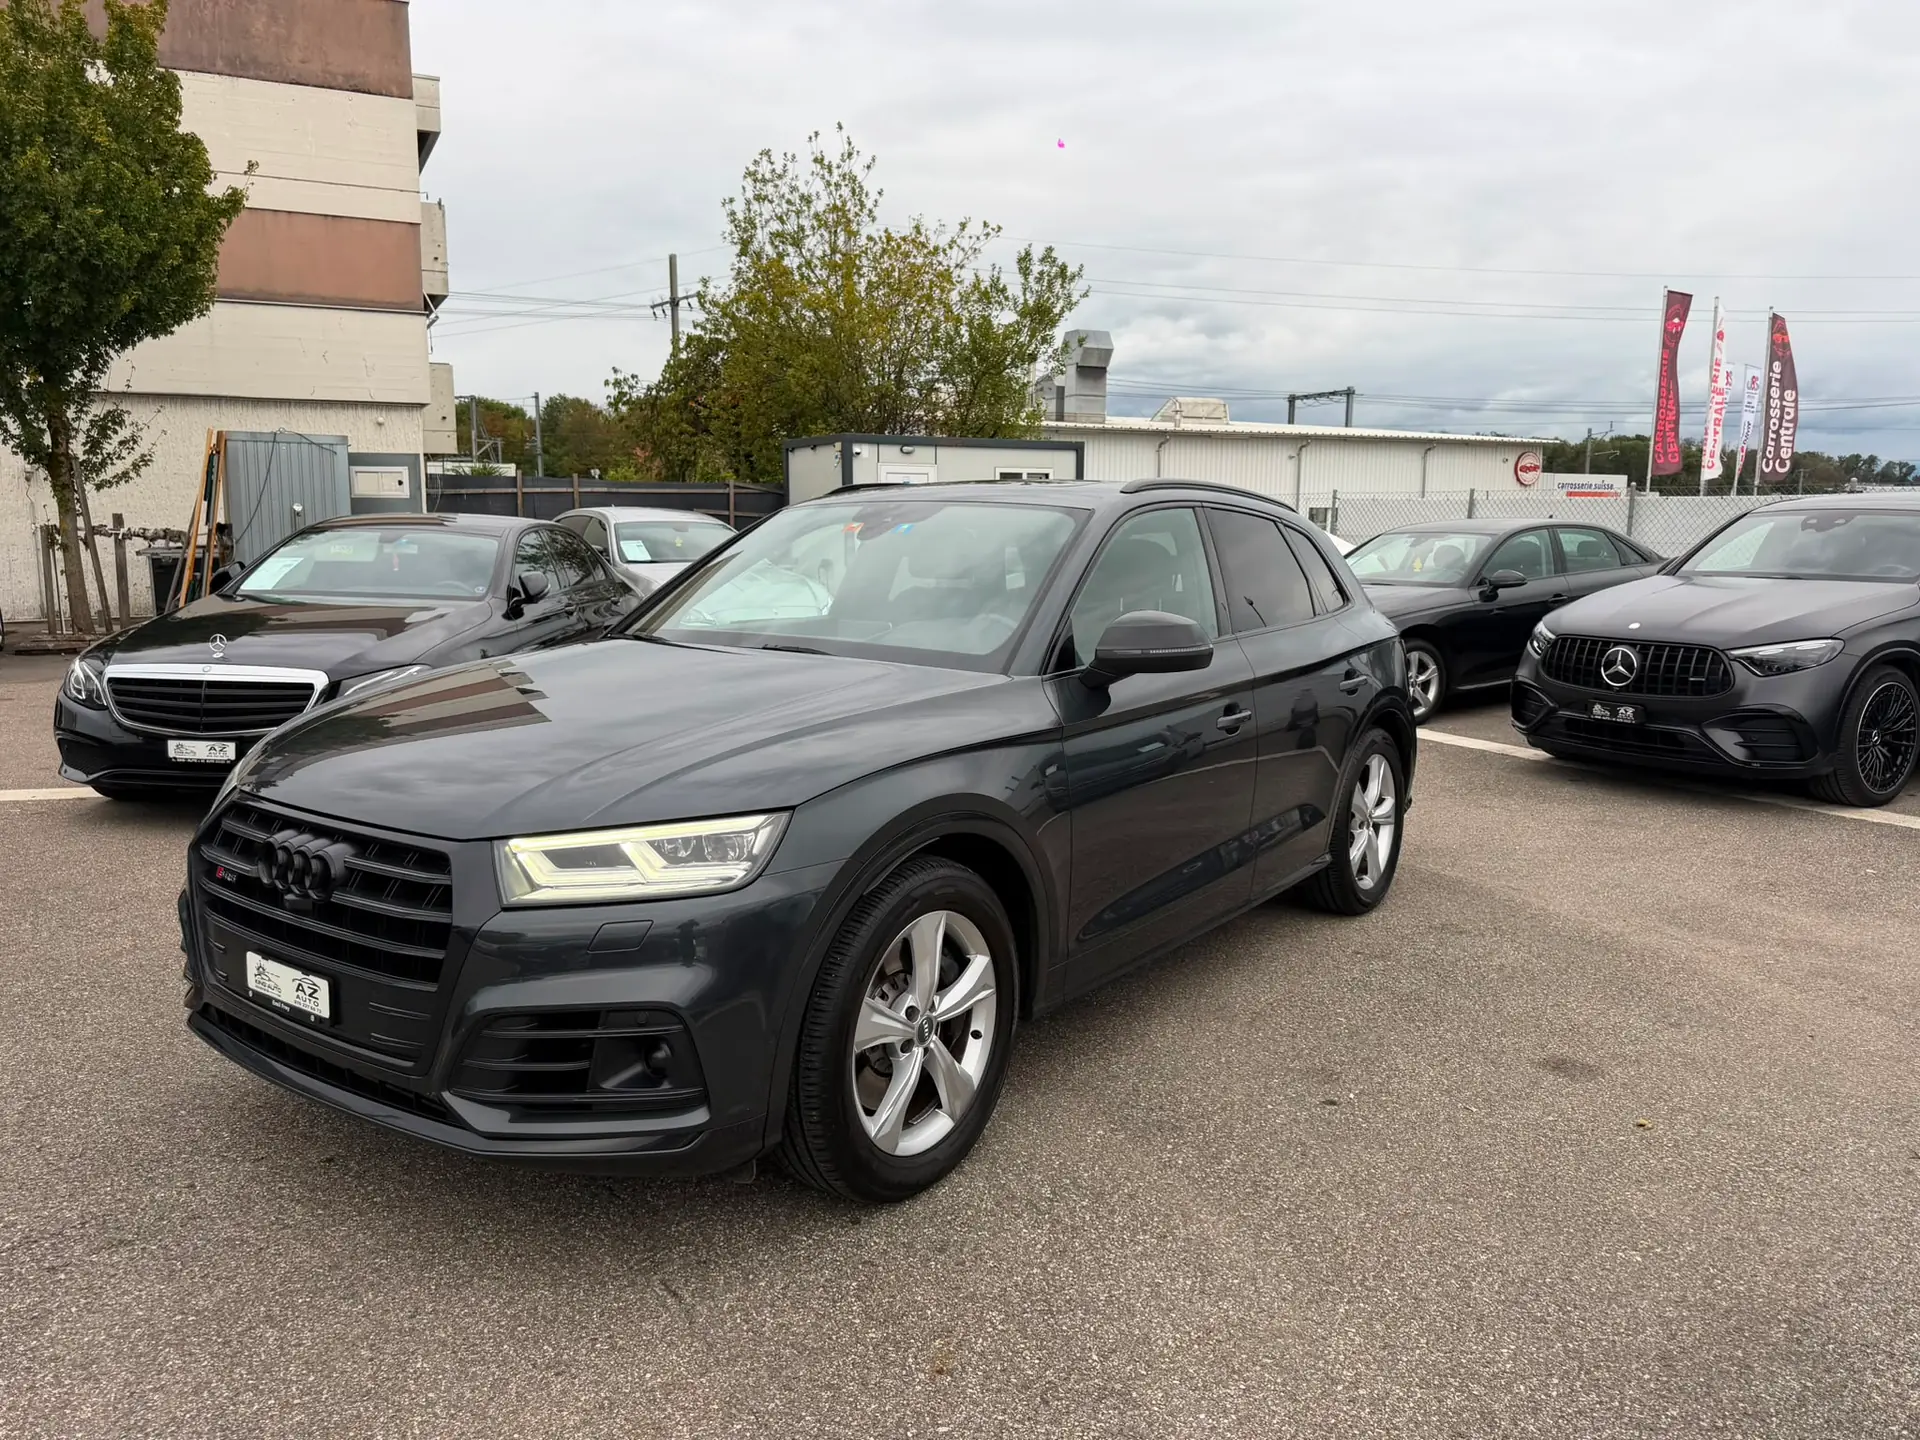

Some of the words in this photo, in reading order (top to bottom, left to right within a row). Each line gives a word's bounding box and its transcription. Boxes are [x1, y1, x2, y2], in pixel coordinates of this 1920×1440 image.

[1706, 387, 1725, 469] CENTRALE
[1762, 361, 1782, 473] Carrosserie
[1775, 389, 1796, 473] Centrale
[1557, 481, 1593, 490] carrosserie
[1593, 480, 1614, 490] suisse
[296, 983, 319, 1000] AZ
[296, 994, 319, 1007] AUTO
